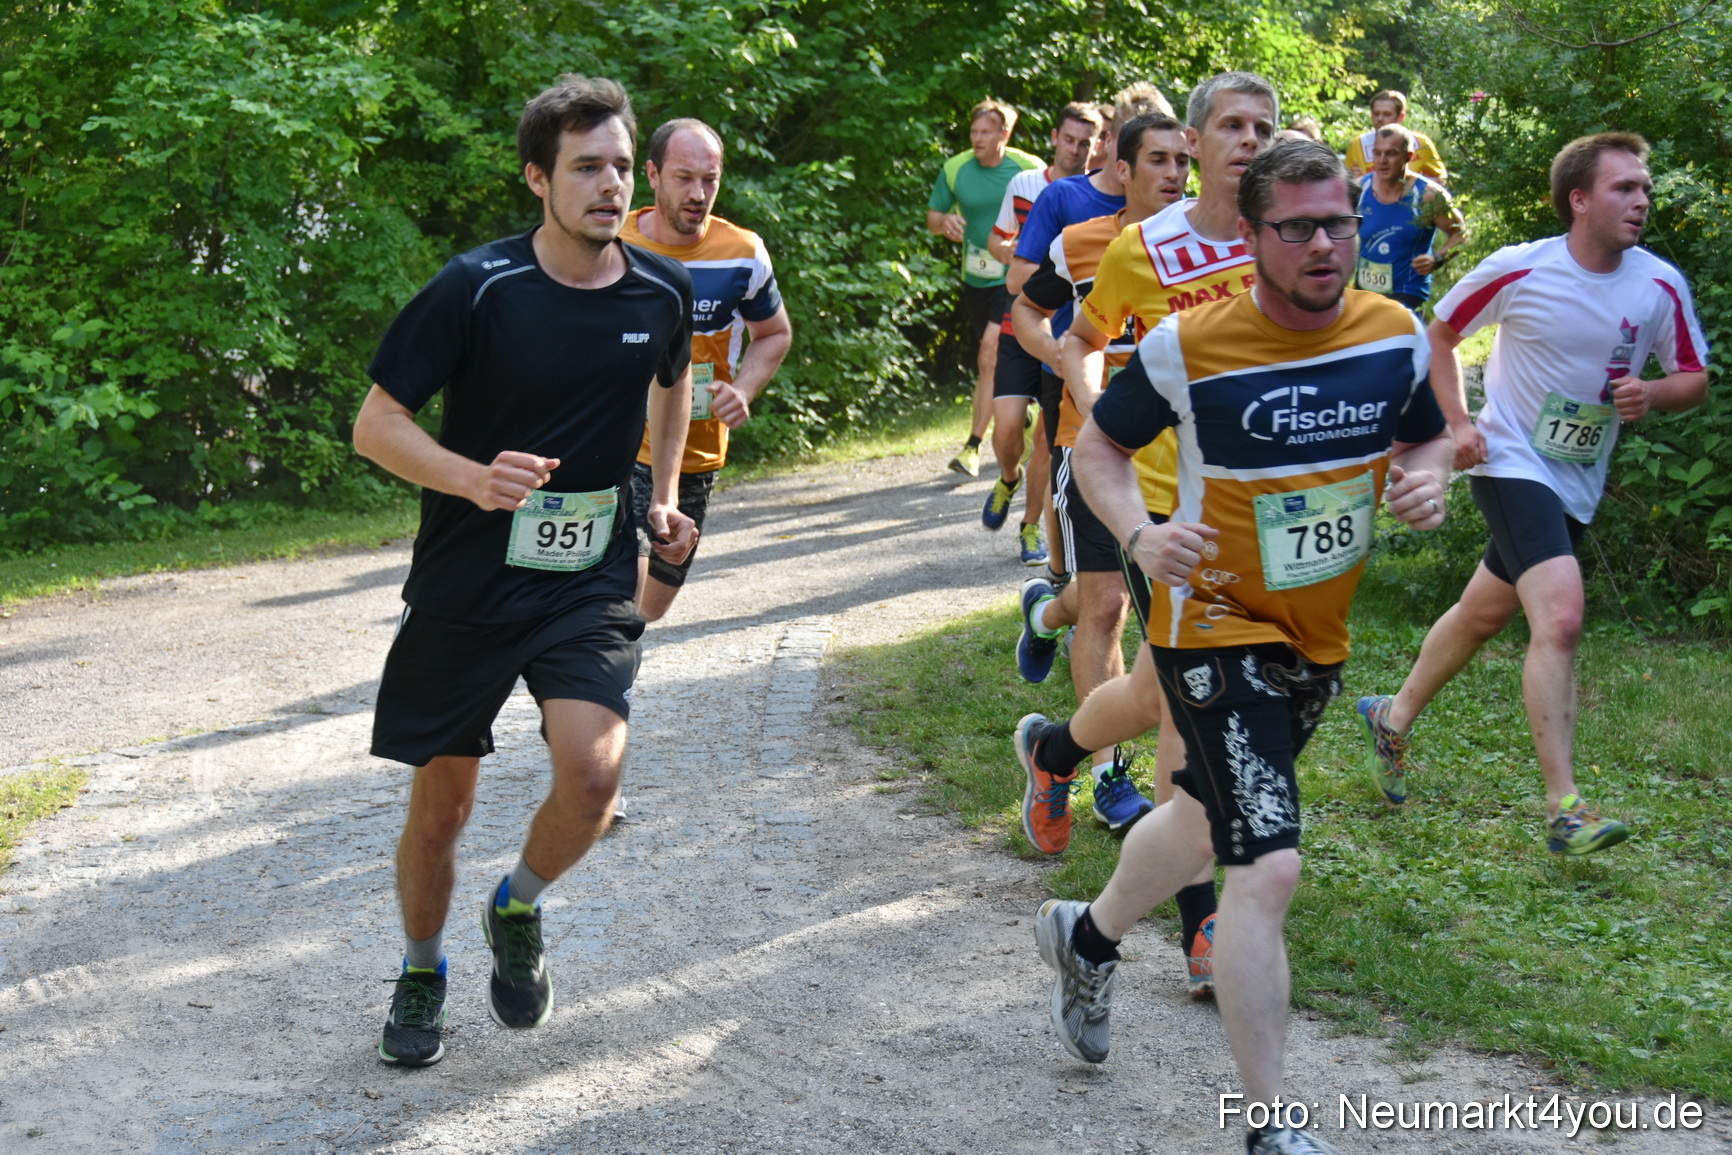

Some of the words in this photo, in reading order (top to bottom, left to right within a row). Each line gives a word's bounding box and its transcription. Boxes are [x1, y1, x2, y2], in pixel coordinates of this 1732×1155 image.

[979, 260, 987, 270] 9
[1361, 270, 1387, 286] 1530
[1167, 280, 1234, 313] MAX
[622, 332, 650, 344] PHILIPP
[1271, 400, 1389, 433] Fischer
[1285, 423, 1380, 446] AUTOMOBILE
[1548, 419, 1604, 447] 1786
[536, 519, 595, 550] 951
[1286, 514, 1354, 560] 788
[565, 550, 591, 558] Philipp
